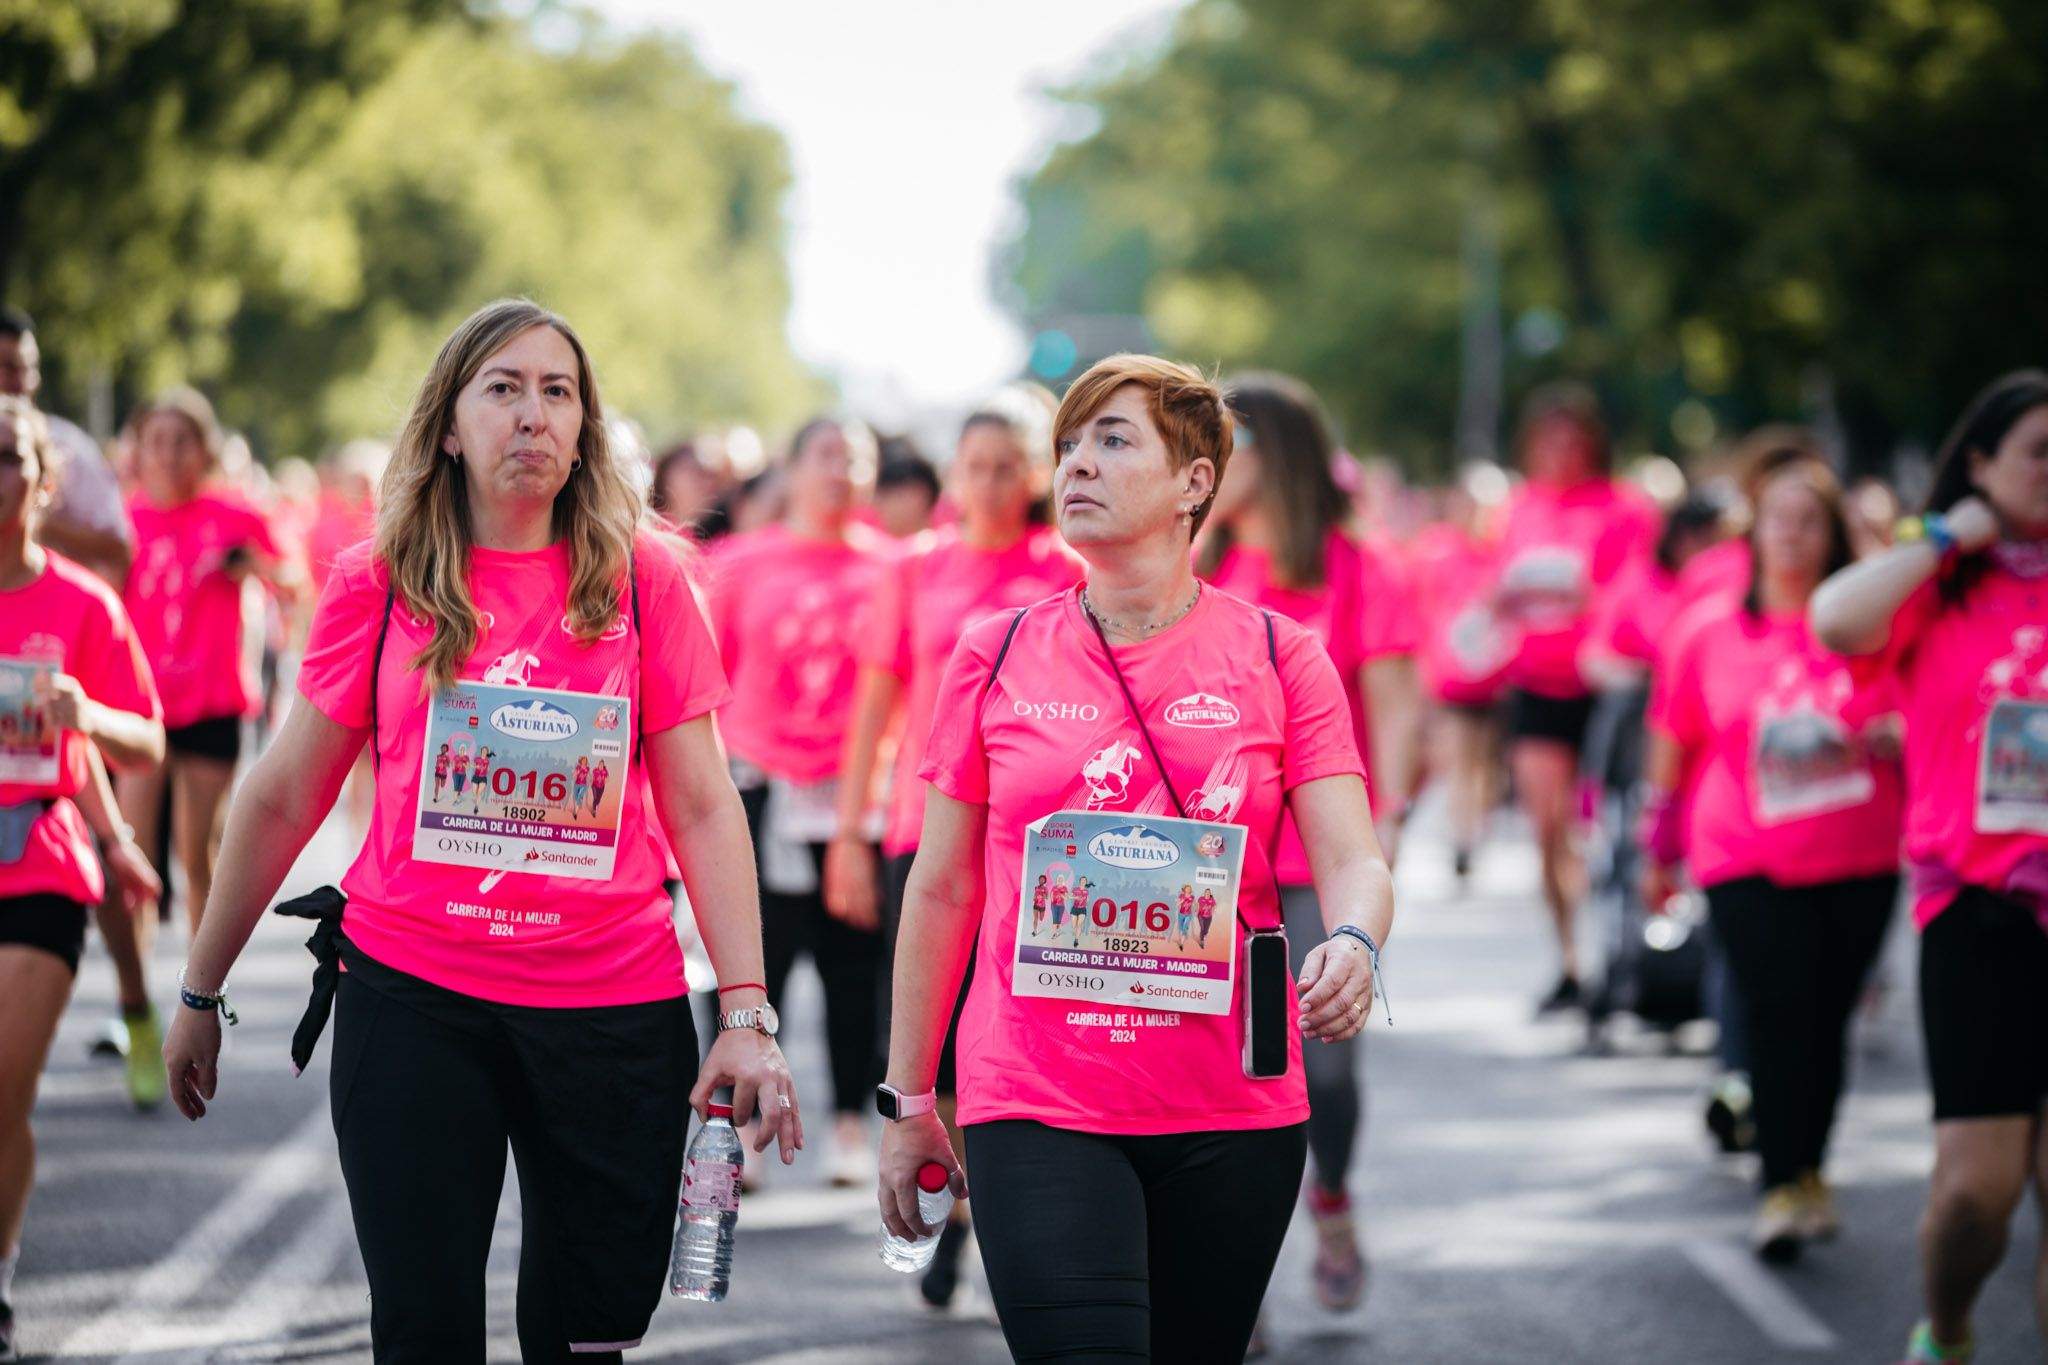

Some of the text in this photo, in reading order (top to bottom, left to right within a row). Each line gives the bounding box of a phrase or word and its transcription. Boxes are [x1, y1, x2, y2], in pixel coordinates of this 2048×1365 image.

[1013, 700, 1099, 721] OYSHO
[1171, 707, 1235, 722] ASTURIANA
[496, 711, 572, 734] ASTURIANA
[491, 767, 567, 802] 016
[502, 805, 546, 822] 18902
[442, 816, 598, 842] CARRERA DE LA MUJER MADRID
[1041, 829, 1075, 840] SUMA
[438, 837, 502, 857] OYSHO
[1094, 839, 1173, 862] ASTURIANA
[541, 850, 598, 867] Santander
[445, 901, 561, 925] CARRERA DE LA MUJER
[1091, 898, 1171, 932] 016
[488, 921, 515, 937] 2024
[1103, 937, 1149, 954] 18923
[1041, 950, 1208, 974] CARRERA DE LA MUJER MADRID
[1038, 972, 1104, 991] OYSHO
[1146, 984, 1209, 1000] Santander
[1066, 1012, 1181, 1027] CARRERA DE LA MUJER
[1110, 1029, 1136, 1043] 2024
